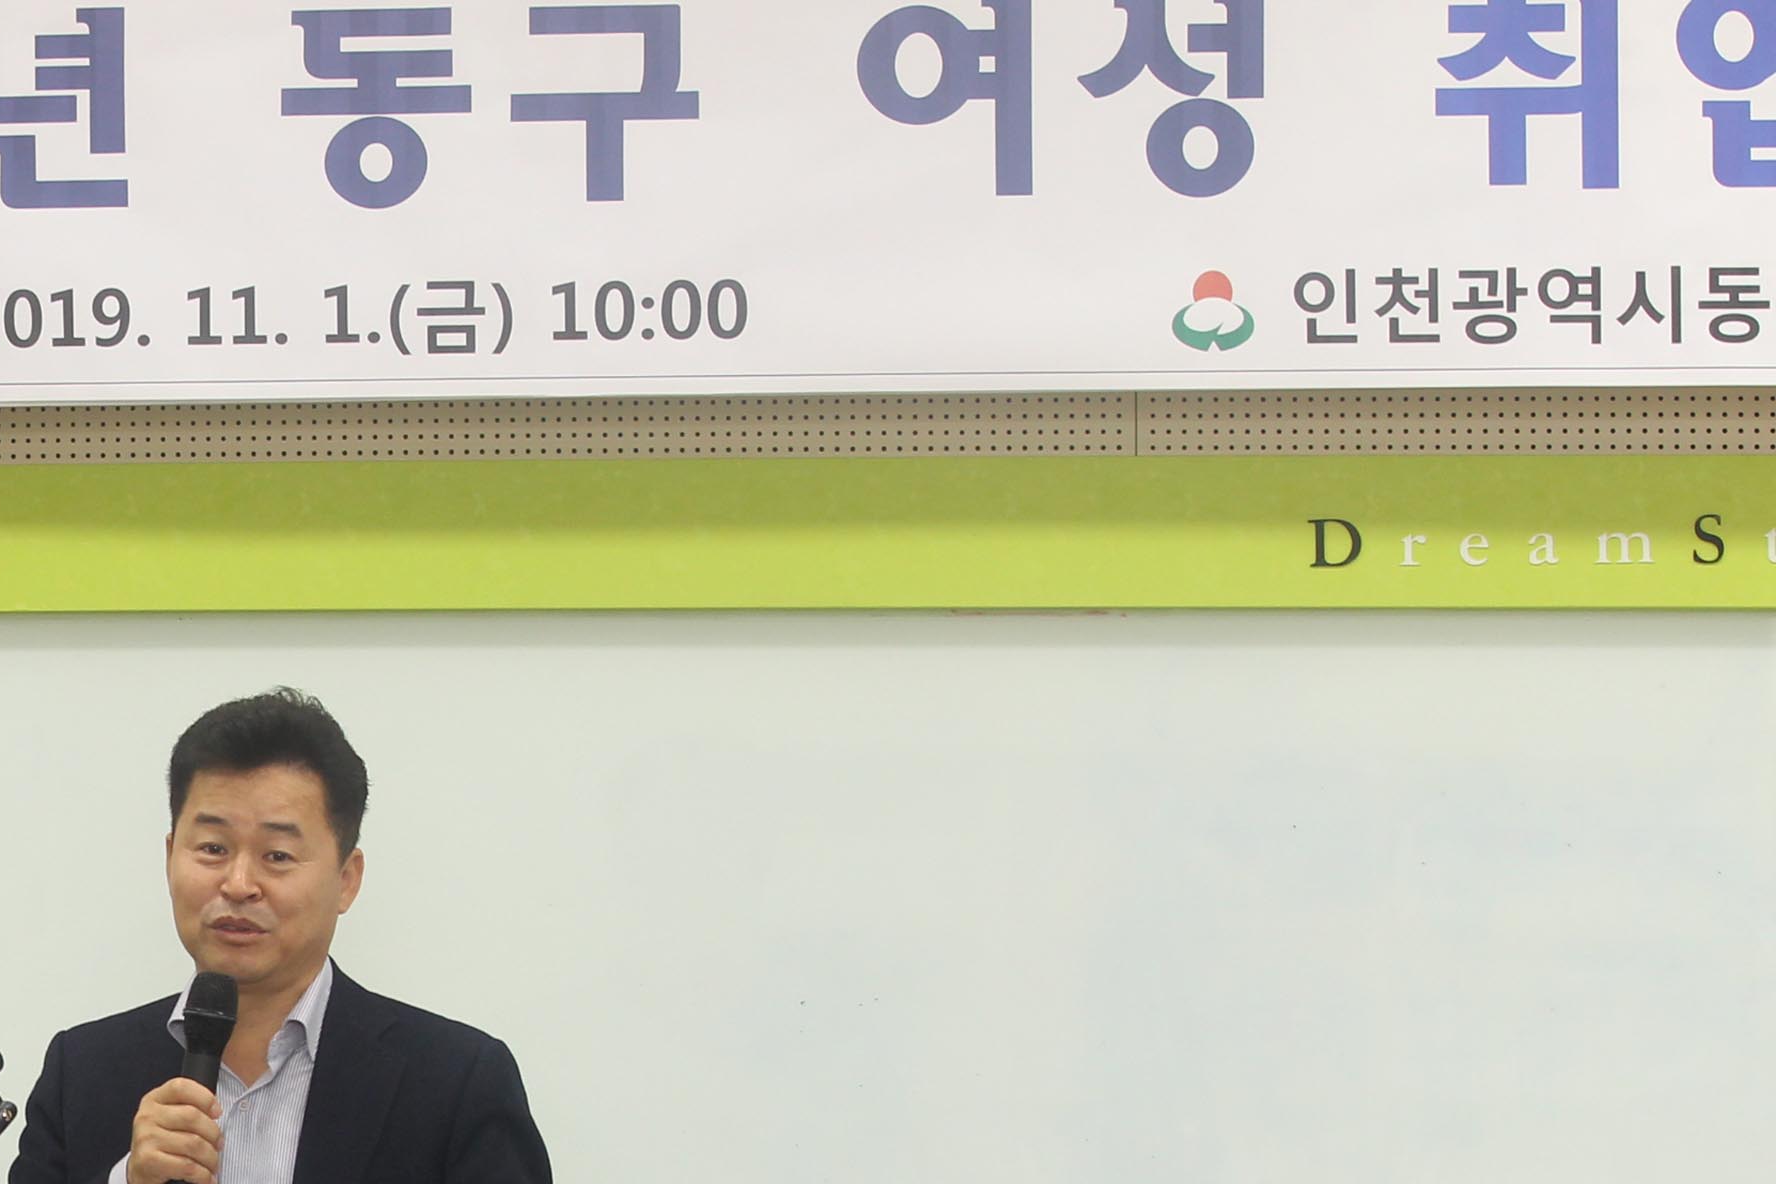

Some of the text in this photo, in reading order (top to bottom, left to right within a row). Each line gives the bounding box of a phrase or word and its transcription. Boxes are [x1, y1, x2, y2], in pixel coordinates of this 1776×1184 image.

[281, 4, 700, 209] 동구
[857, 0, 1265, 198] 여성
[187, 285, 288, 346] 11.
[551, 278, 748, 342] 10:00
